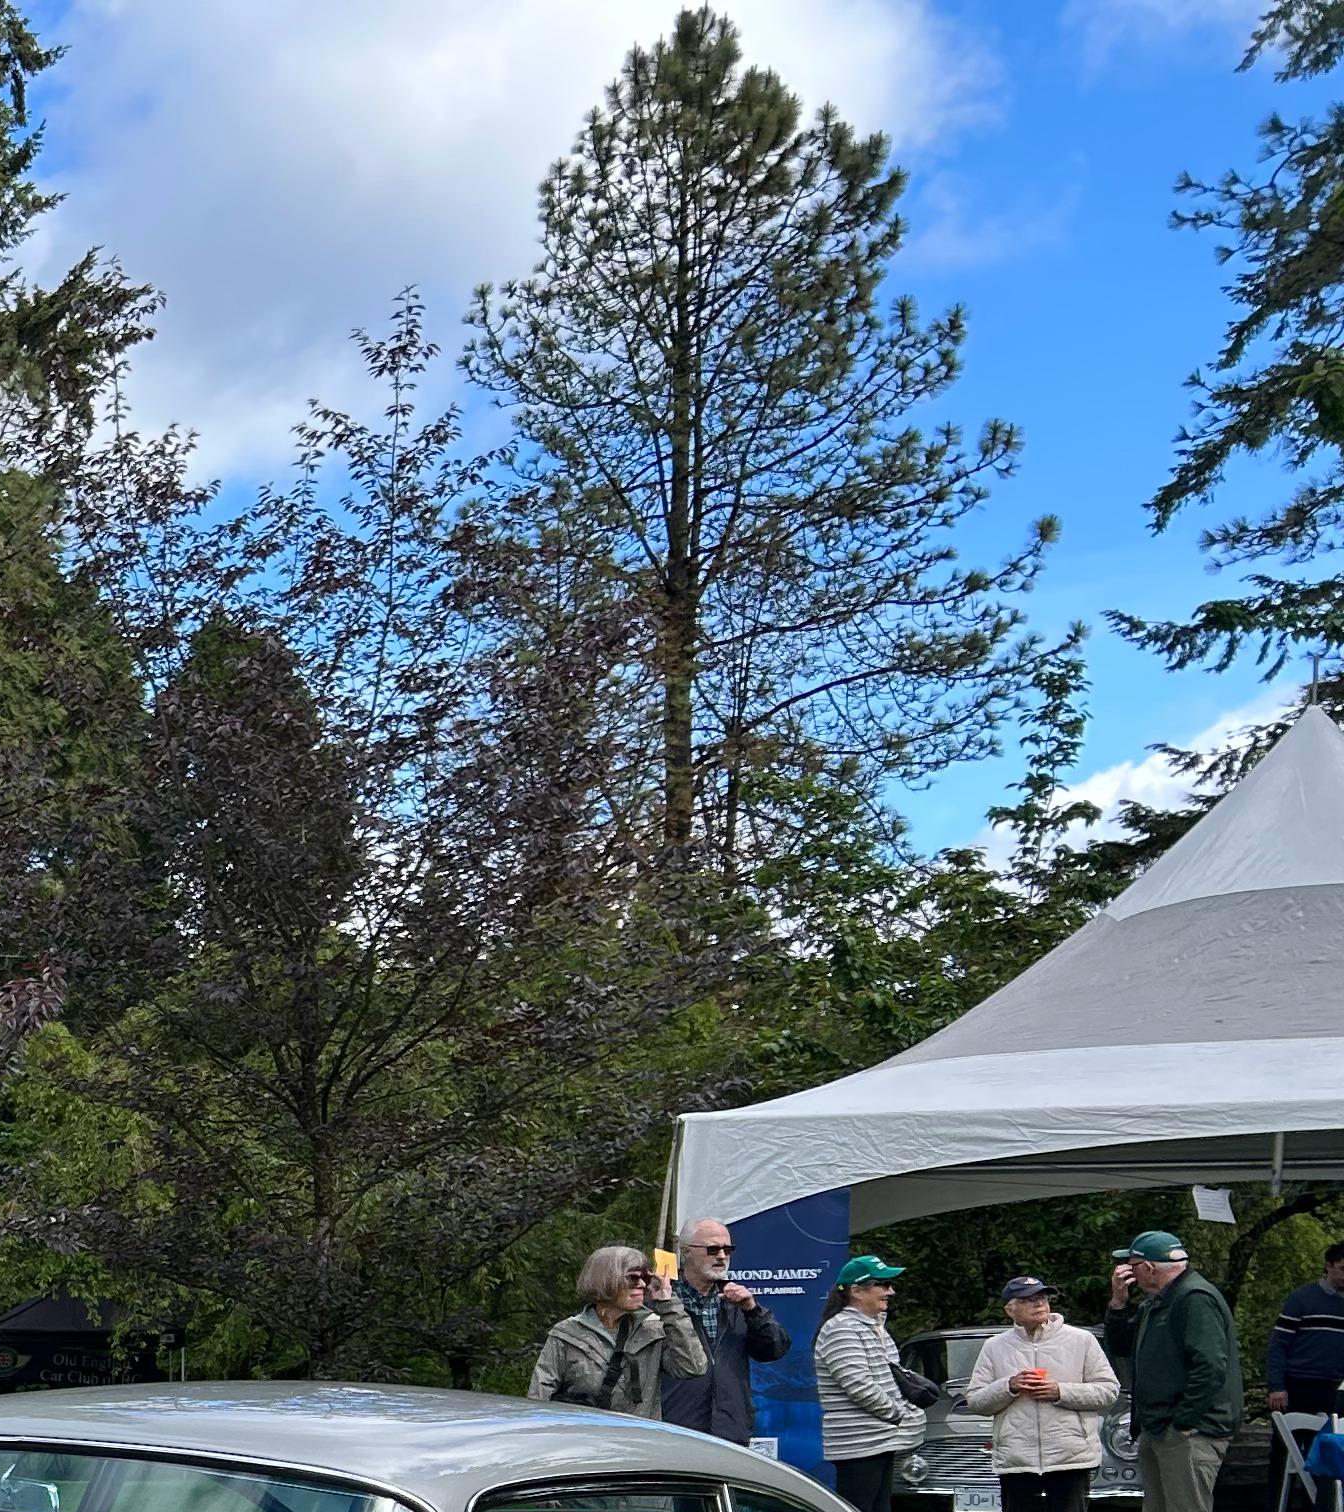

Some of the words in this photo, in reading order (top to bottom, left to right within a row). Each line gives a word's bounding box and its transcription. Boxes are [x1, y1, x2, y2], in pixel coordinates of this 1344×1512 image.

[53, 1353, 77, 1366] Old
[40, 1369, 64, 1381] Car
[67, 1370, 98, 1384] Club
